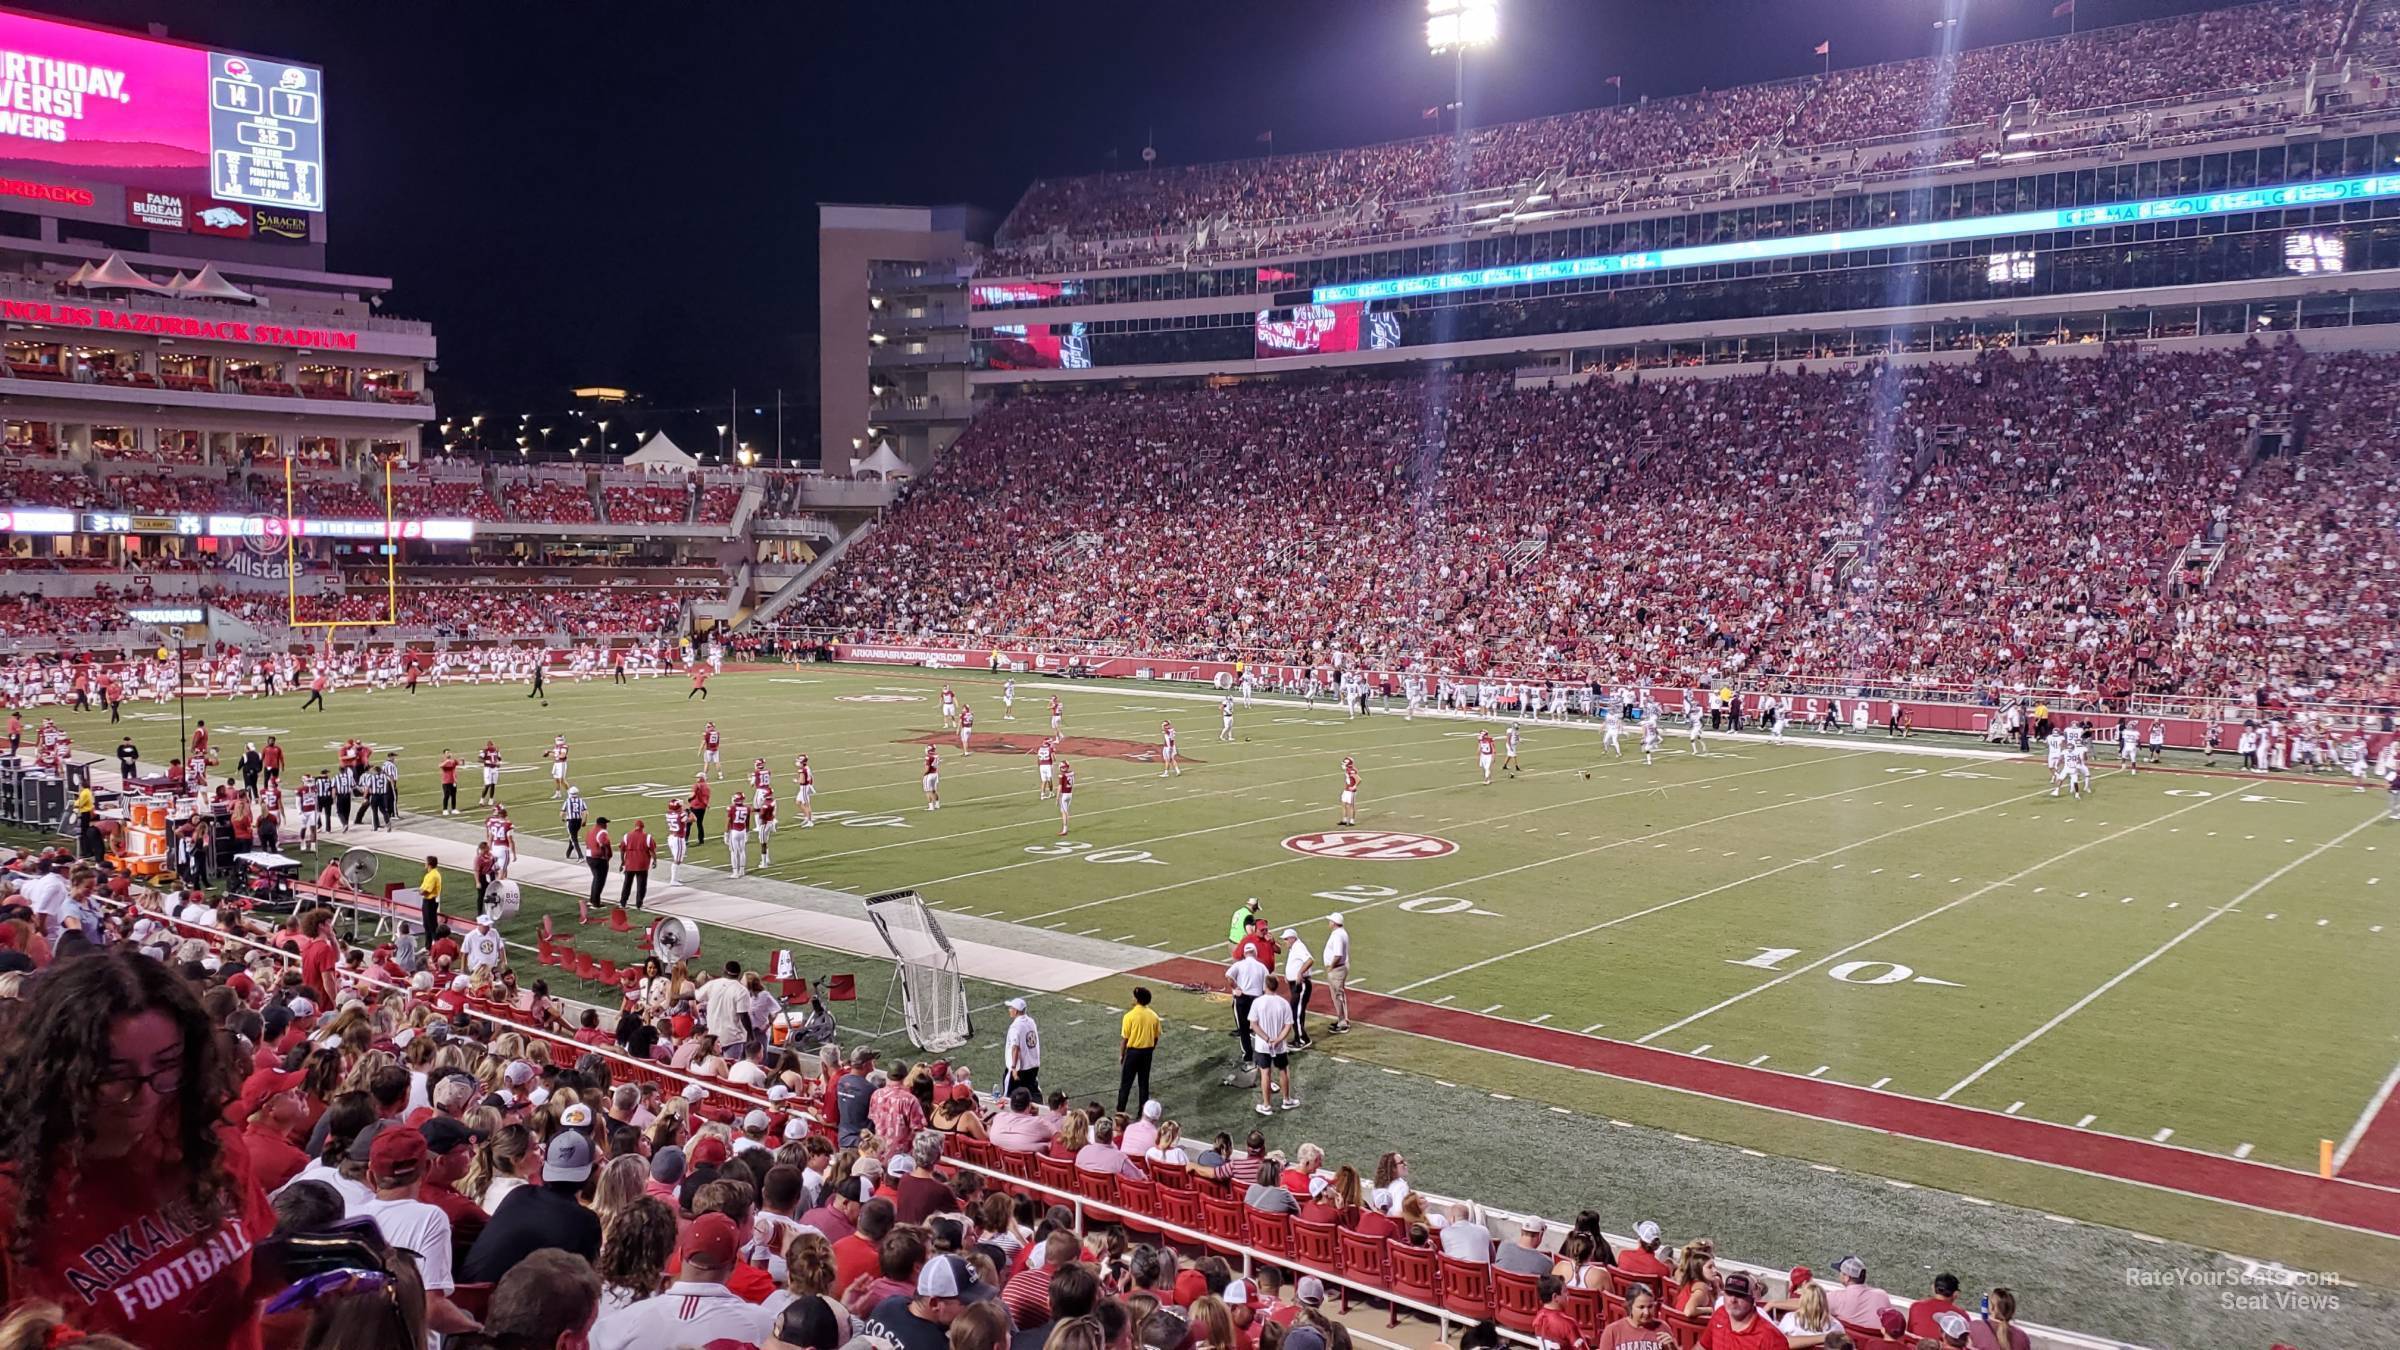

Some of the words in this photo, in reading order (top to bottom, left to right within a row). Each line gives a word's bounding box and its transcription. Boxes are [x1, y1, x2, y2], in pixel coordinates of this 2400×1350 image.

[229, 84, 247, 108] 14
[286, 93, 303, 117] 17
[133, 202, 183, 217] BUREAU
[147, 193, 181, 208] FARM
[98, 309, 250, 342] RAZORBACK
[255, 325, 358, 350] STADIUM
[226, 553, 304, 580] Allstate
[851, 649, 965, 663] ARKANSASRAZORBACKS.COM
[758, 772, 770, 785] 18
[735, 809, 748, 823] 15
[1024, 841, 1153, 864] 30
[1294, 833, 1444, 858] SEC
[1311, 884, 1474, 914] 20
[1723, 946, 1915, 985] 10
[114, 1221, 252, 1321] FOOTBALL
